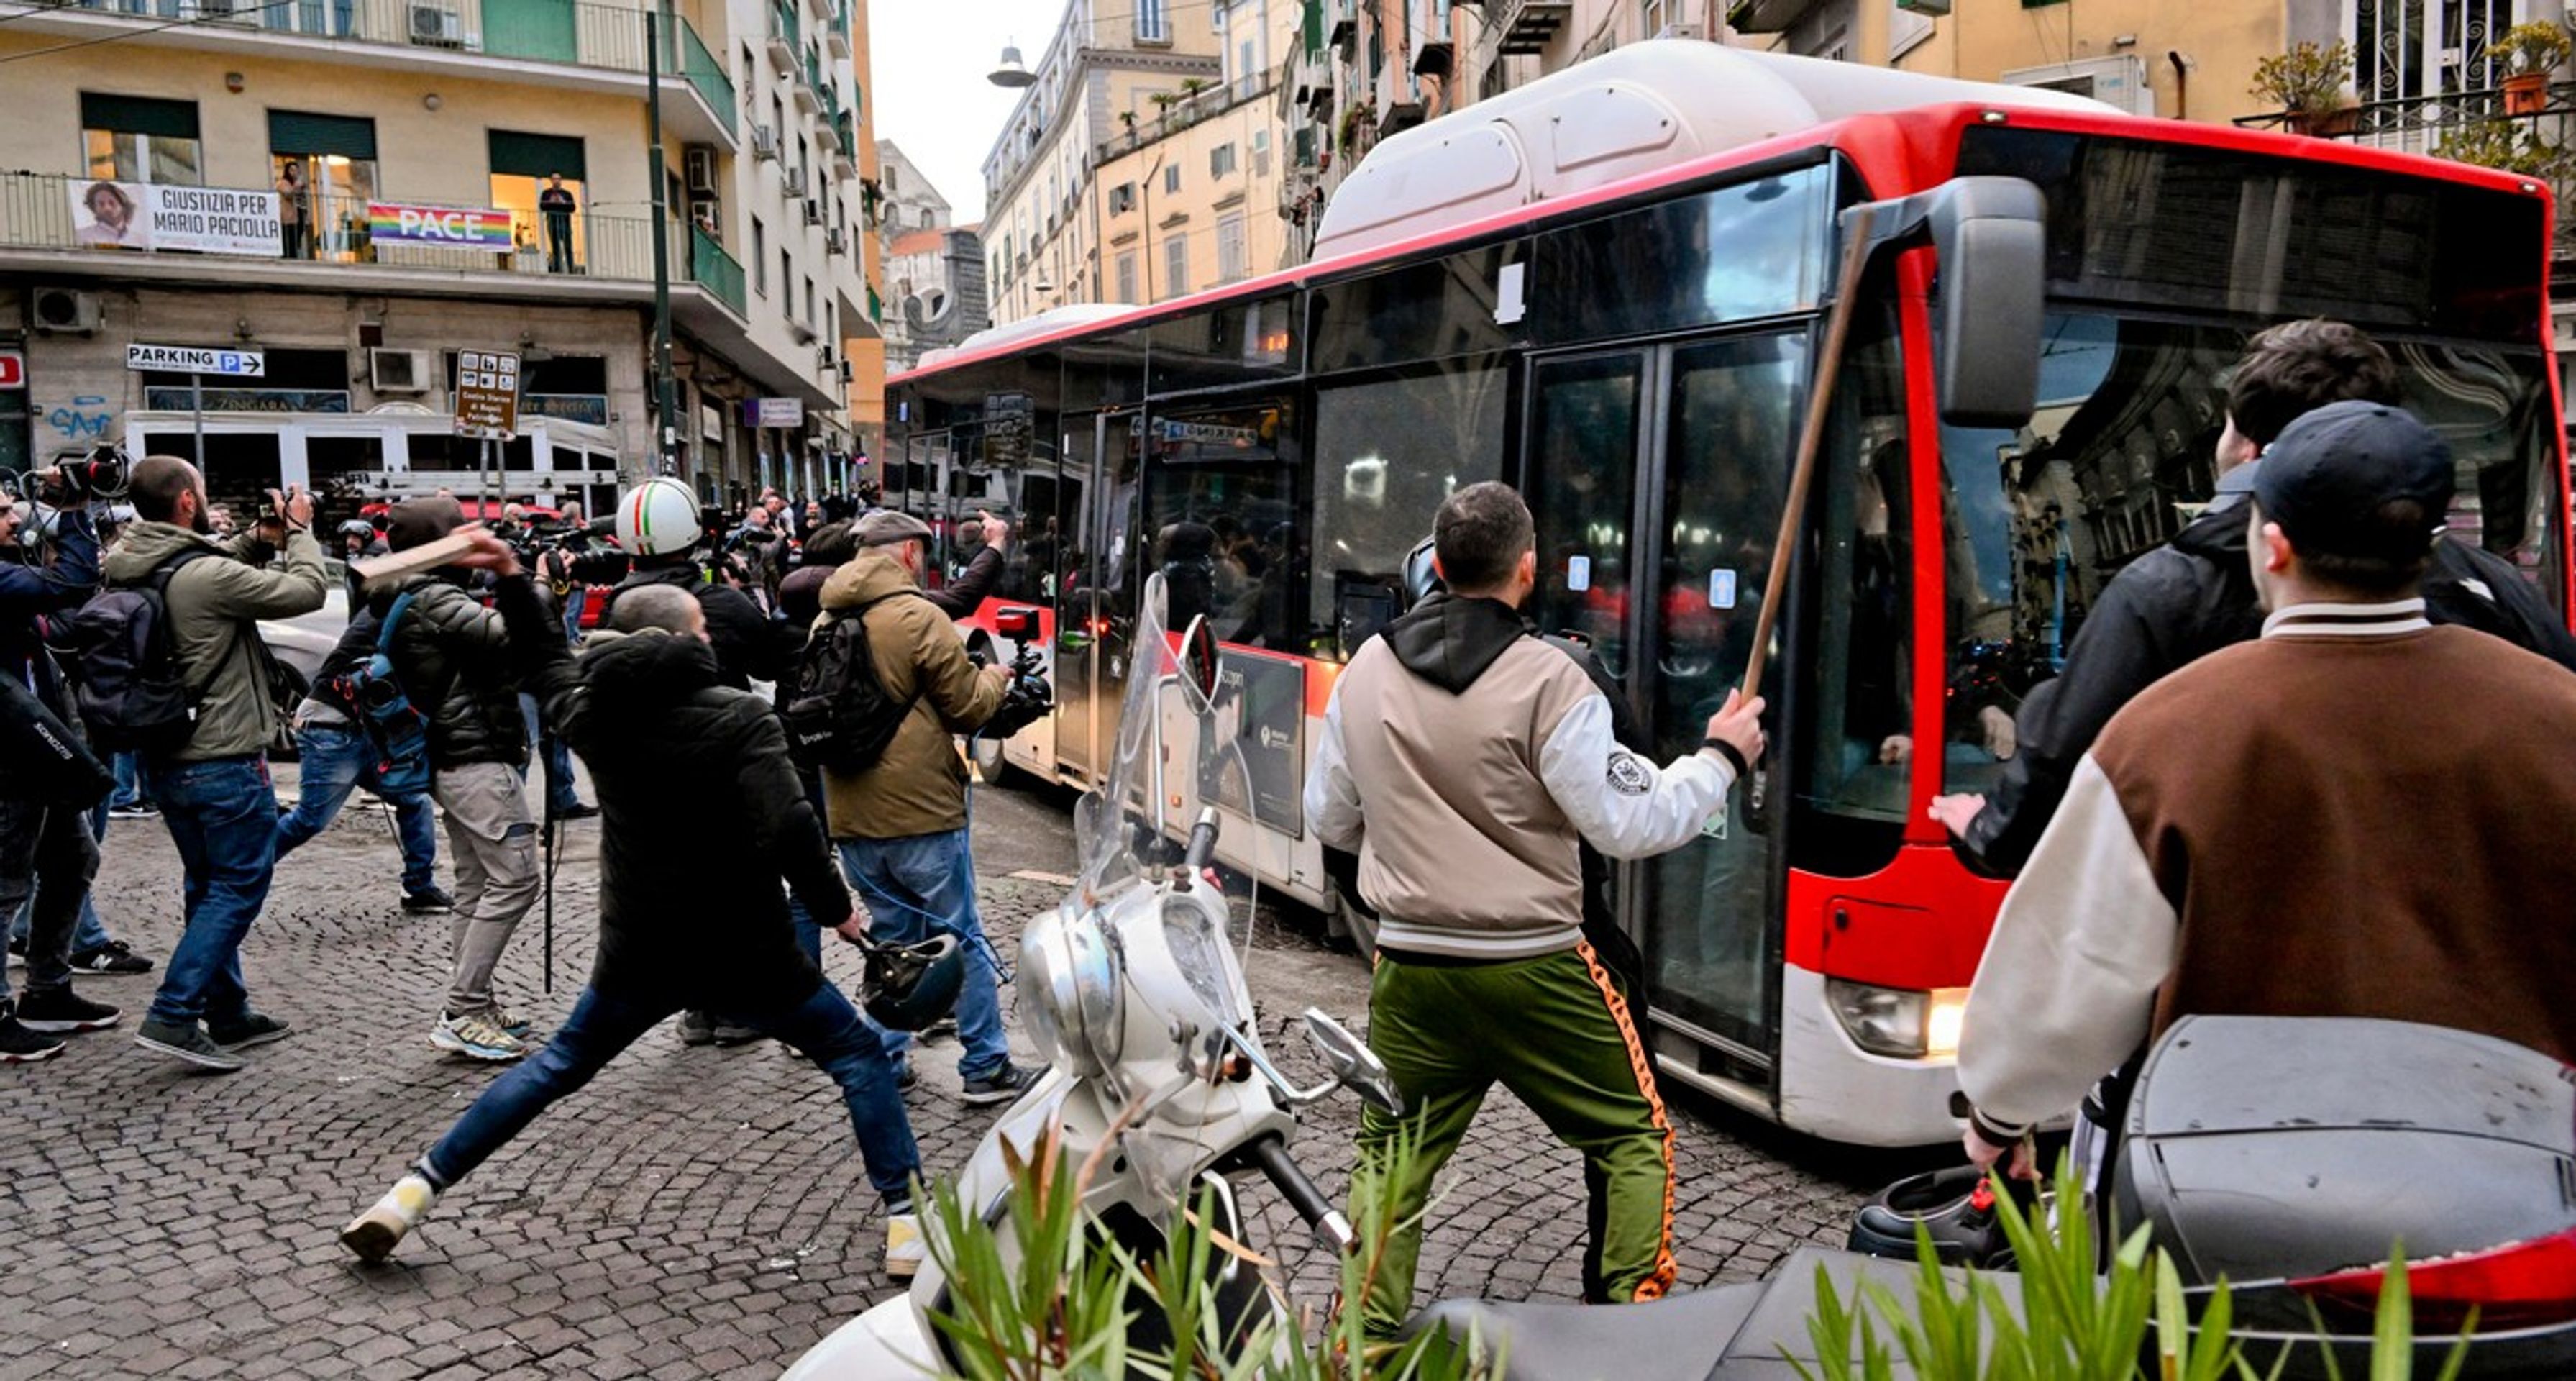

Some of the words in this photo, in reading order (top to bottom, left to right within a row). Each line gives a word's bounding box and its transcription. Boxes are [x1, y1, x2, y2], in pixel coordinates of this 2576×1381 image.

[163, 189, 235, 213] GIUSTIZIA
[239, 196, 268, 215] PER
[154, 212, 204, 234] MARIO
[208, 217, 279, 238] PACIOLLA
[399, 209, 484, 240] PACE
[129, 347, 214, 365] PARKING
